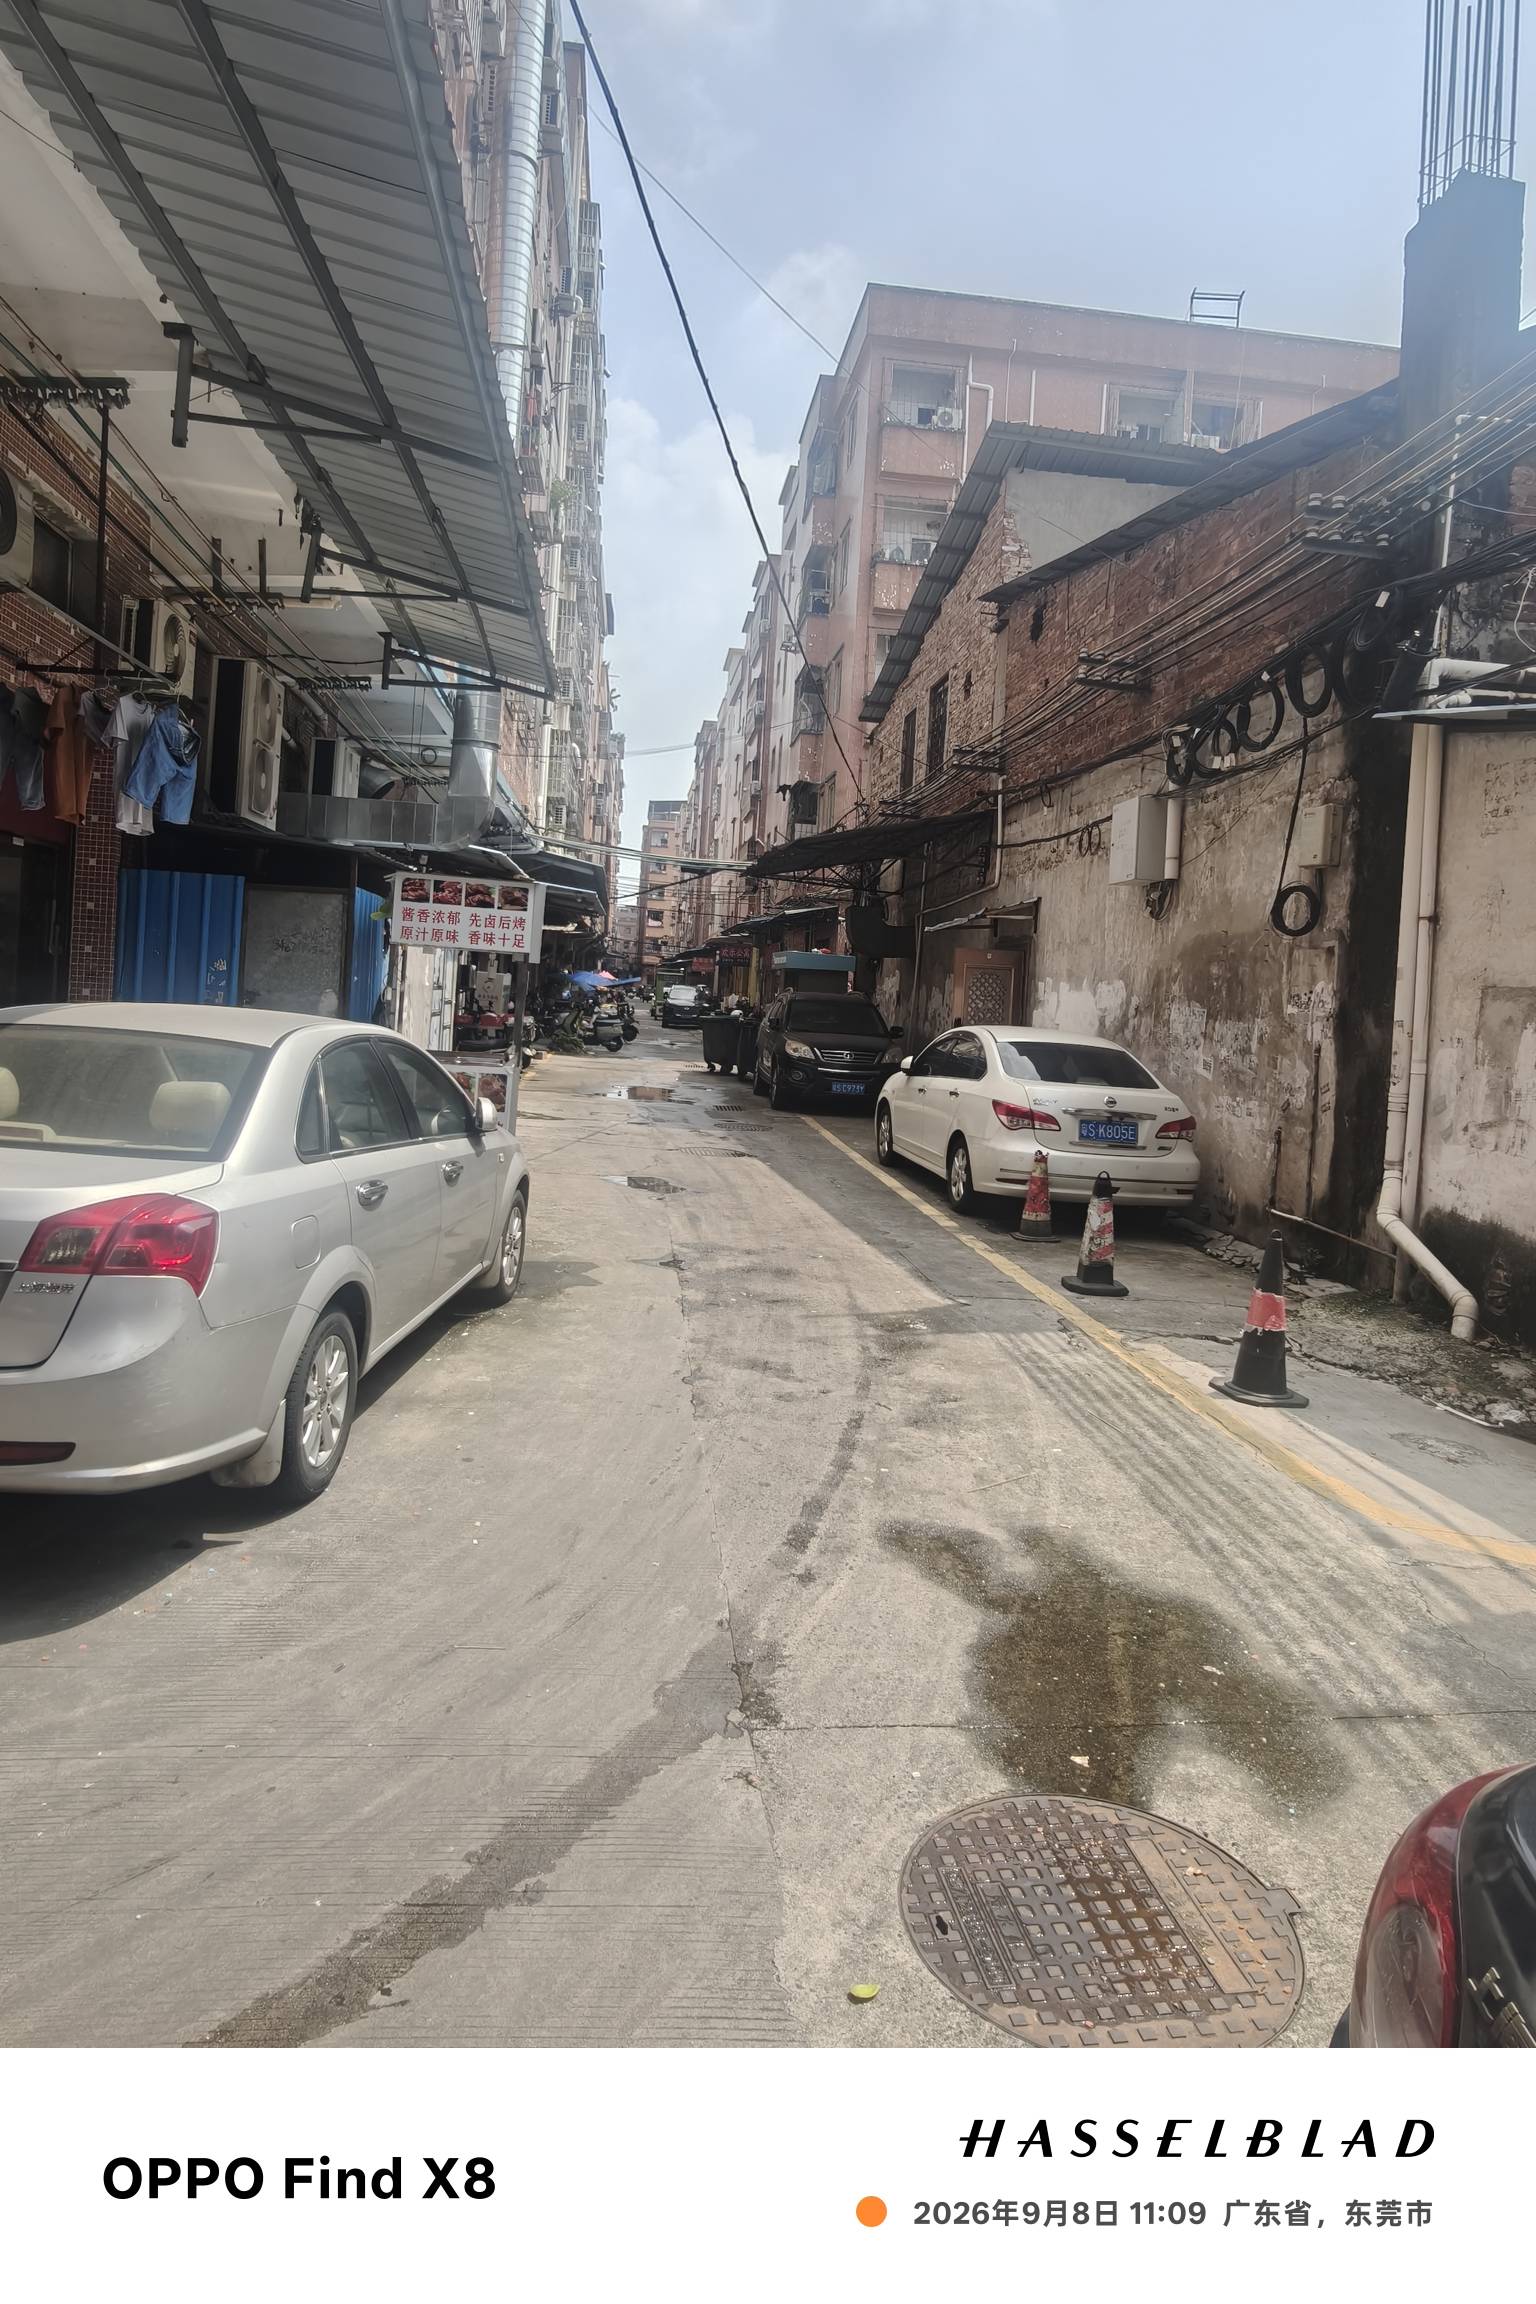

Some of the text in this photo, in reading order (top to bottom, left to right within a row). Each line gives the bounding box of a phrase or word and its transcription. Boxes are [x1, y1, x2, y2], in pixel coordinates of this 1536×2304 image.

[402, 906, 527, 932] 酱香浓郁 先卤后烤
[400, 925, 526, 949] 原汁原味 香味十足
